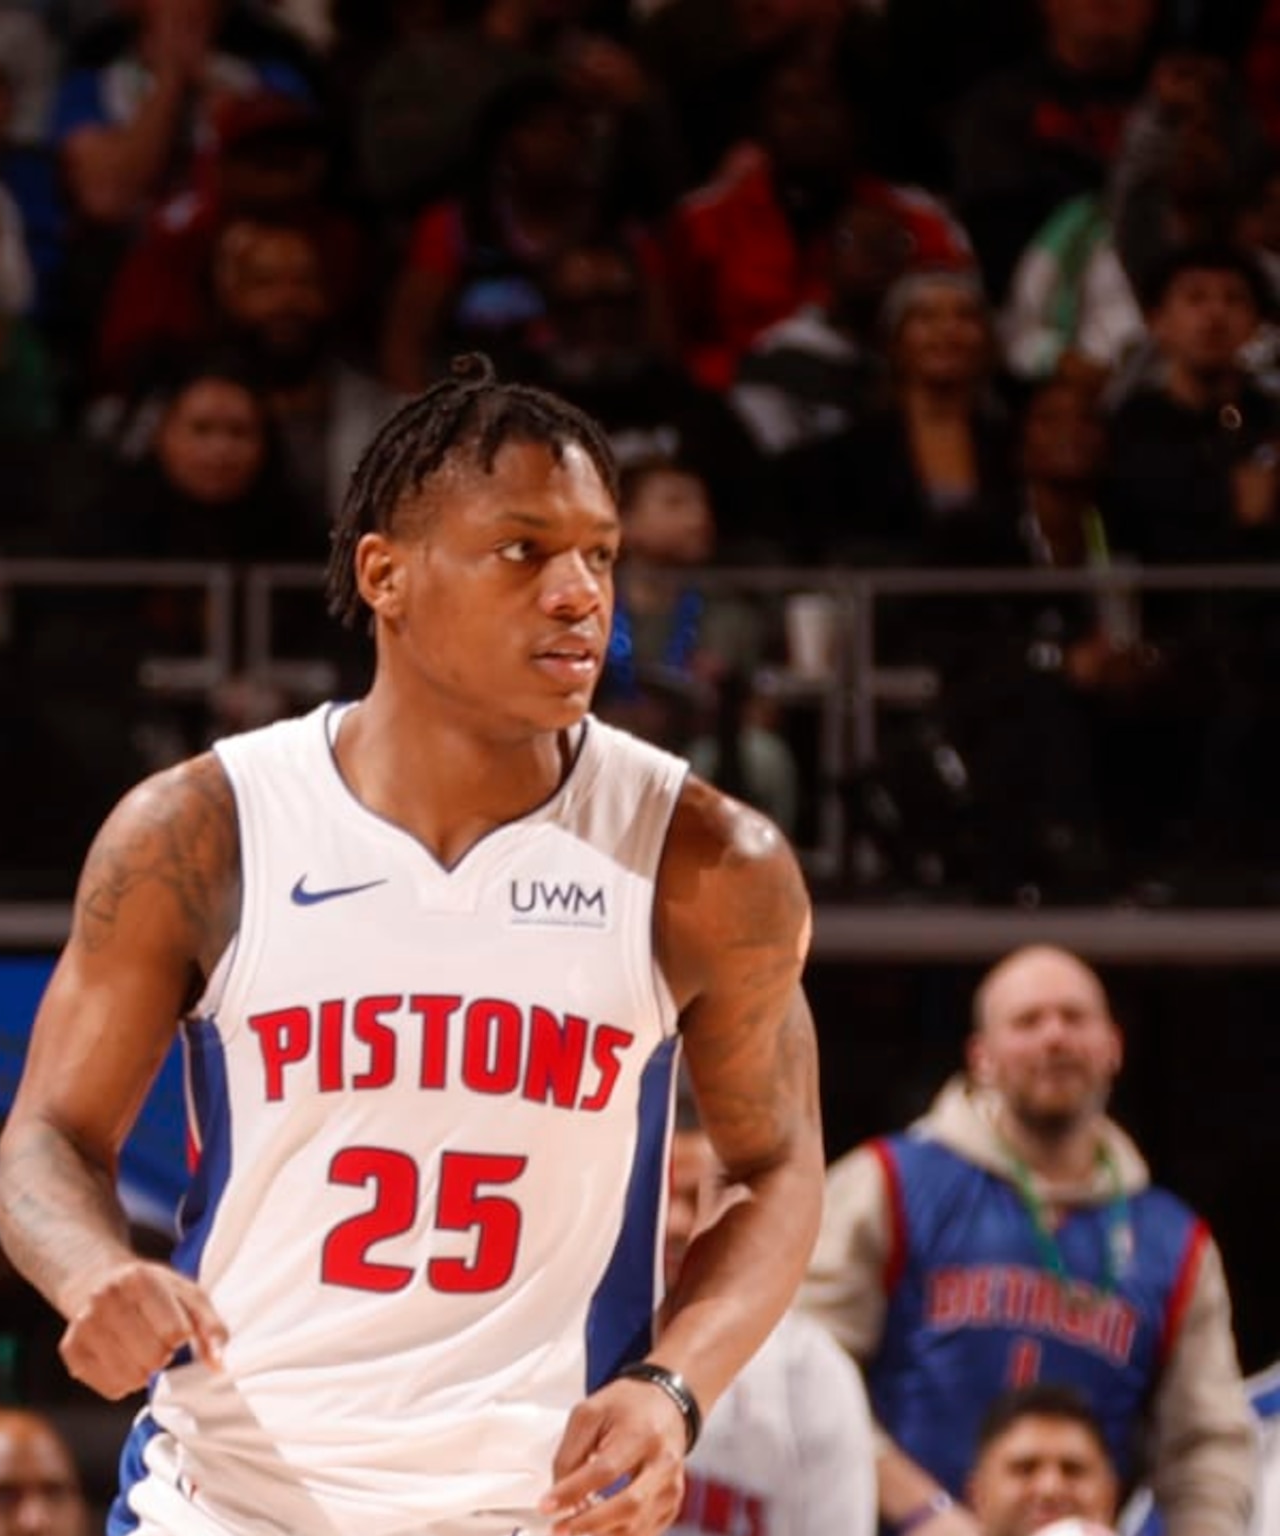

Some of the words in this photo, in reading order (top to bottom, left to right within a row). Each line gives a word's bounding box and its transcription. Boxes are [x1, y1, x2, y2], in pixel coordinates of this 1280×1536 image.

[510, 879, 607, 917] UWM
[247, 994, 635, 1112] PISTONS
[320, 1144, 529, 1295] 25
